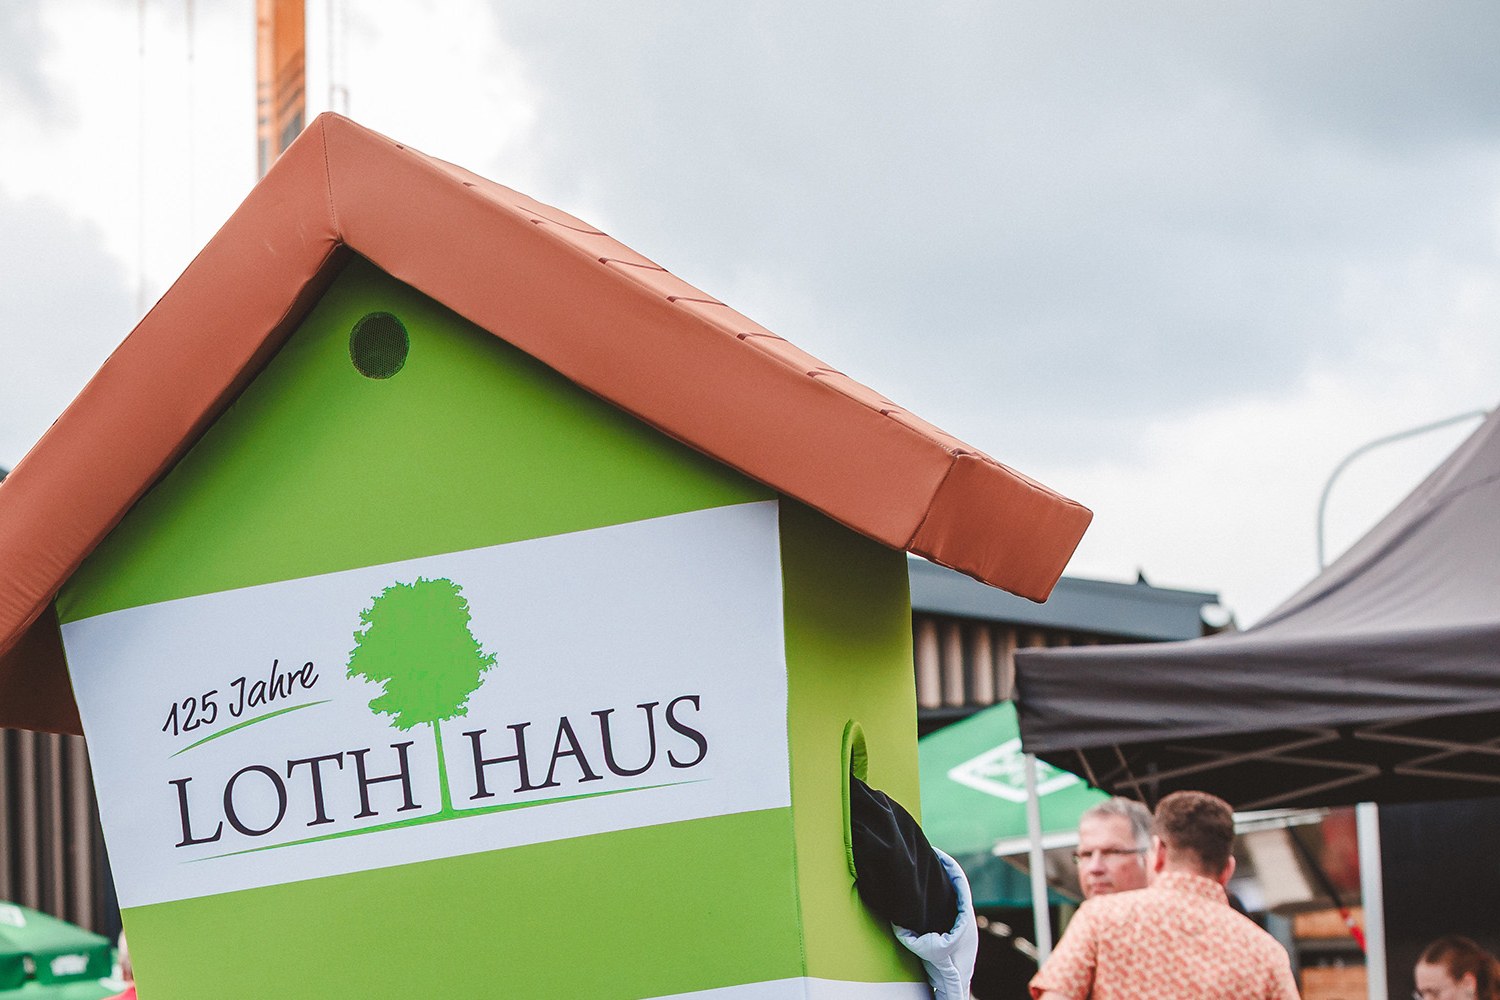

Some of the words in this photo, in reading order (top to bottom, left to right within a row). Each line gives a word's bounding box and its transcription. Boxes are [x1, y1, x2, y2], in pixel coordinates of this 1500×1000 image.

[162, 690, 218, 736] 125
[229, 659, 319, 717] Jahre
[168, 740, 423, 848] LOTH
[461, 695, 709, 801] HAUS
